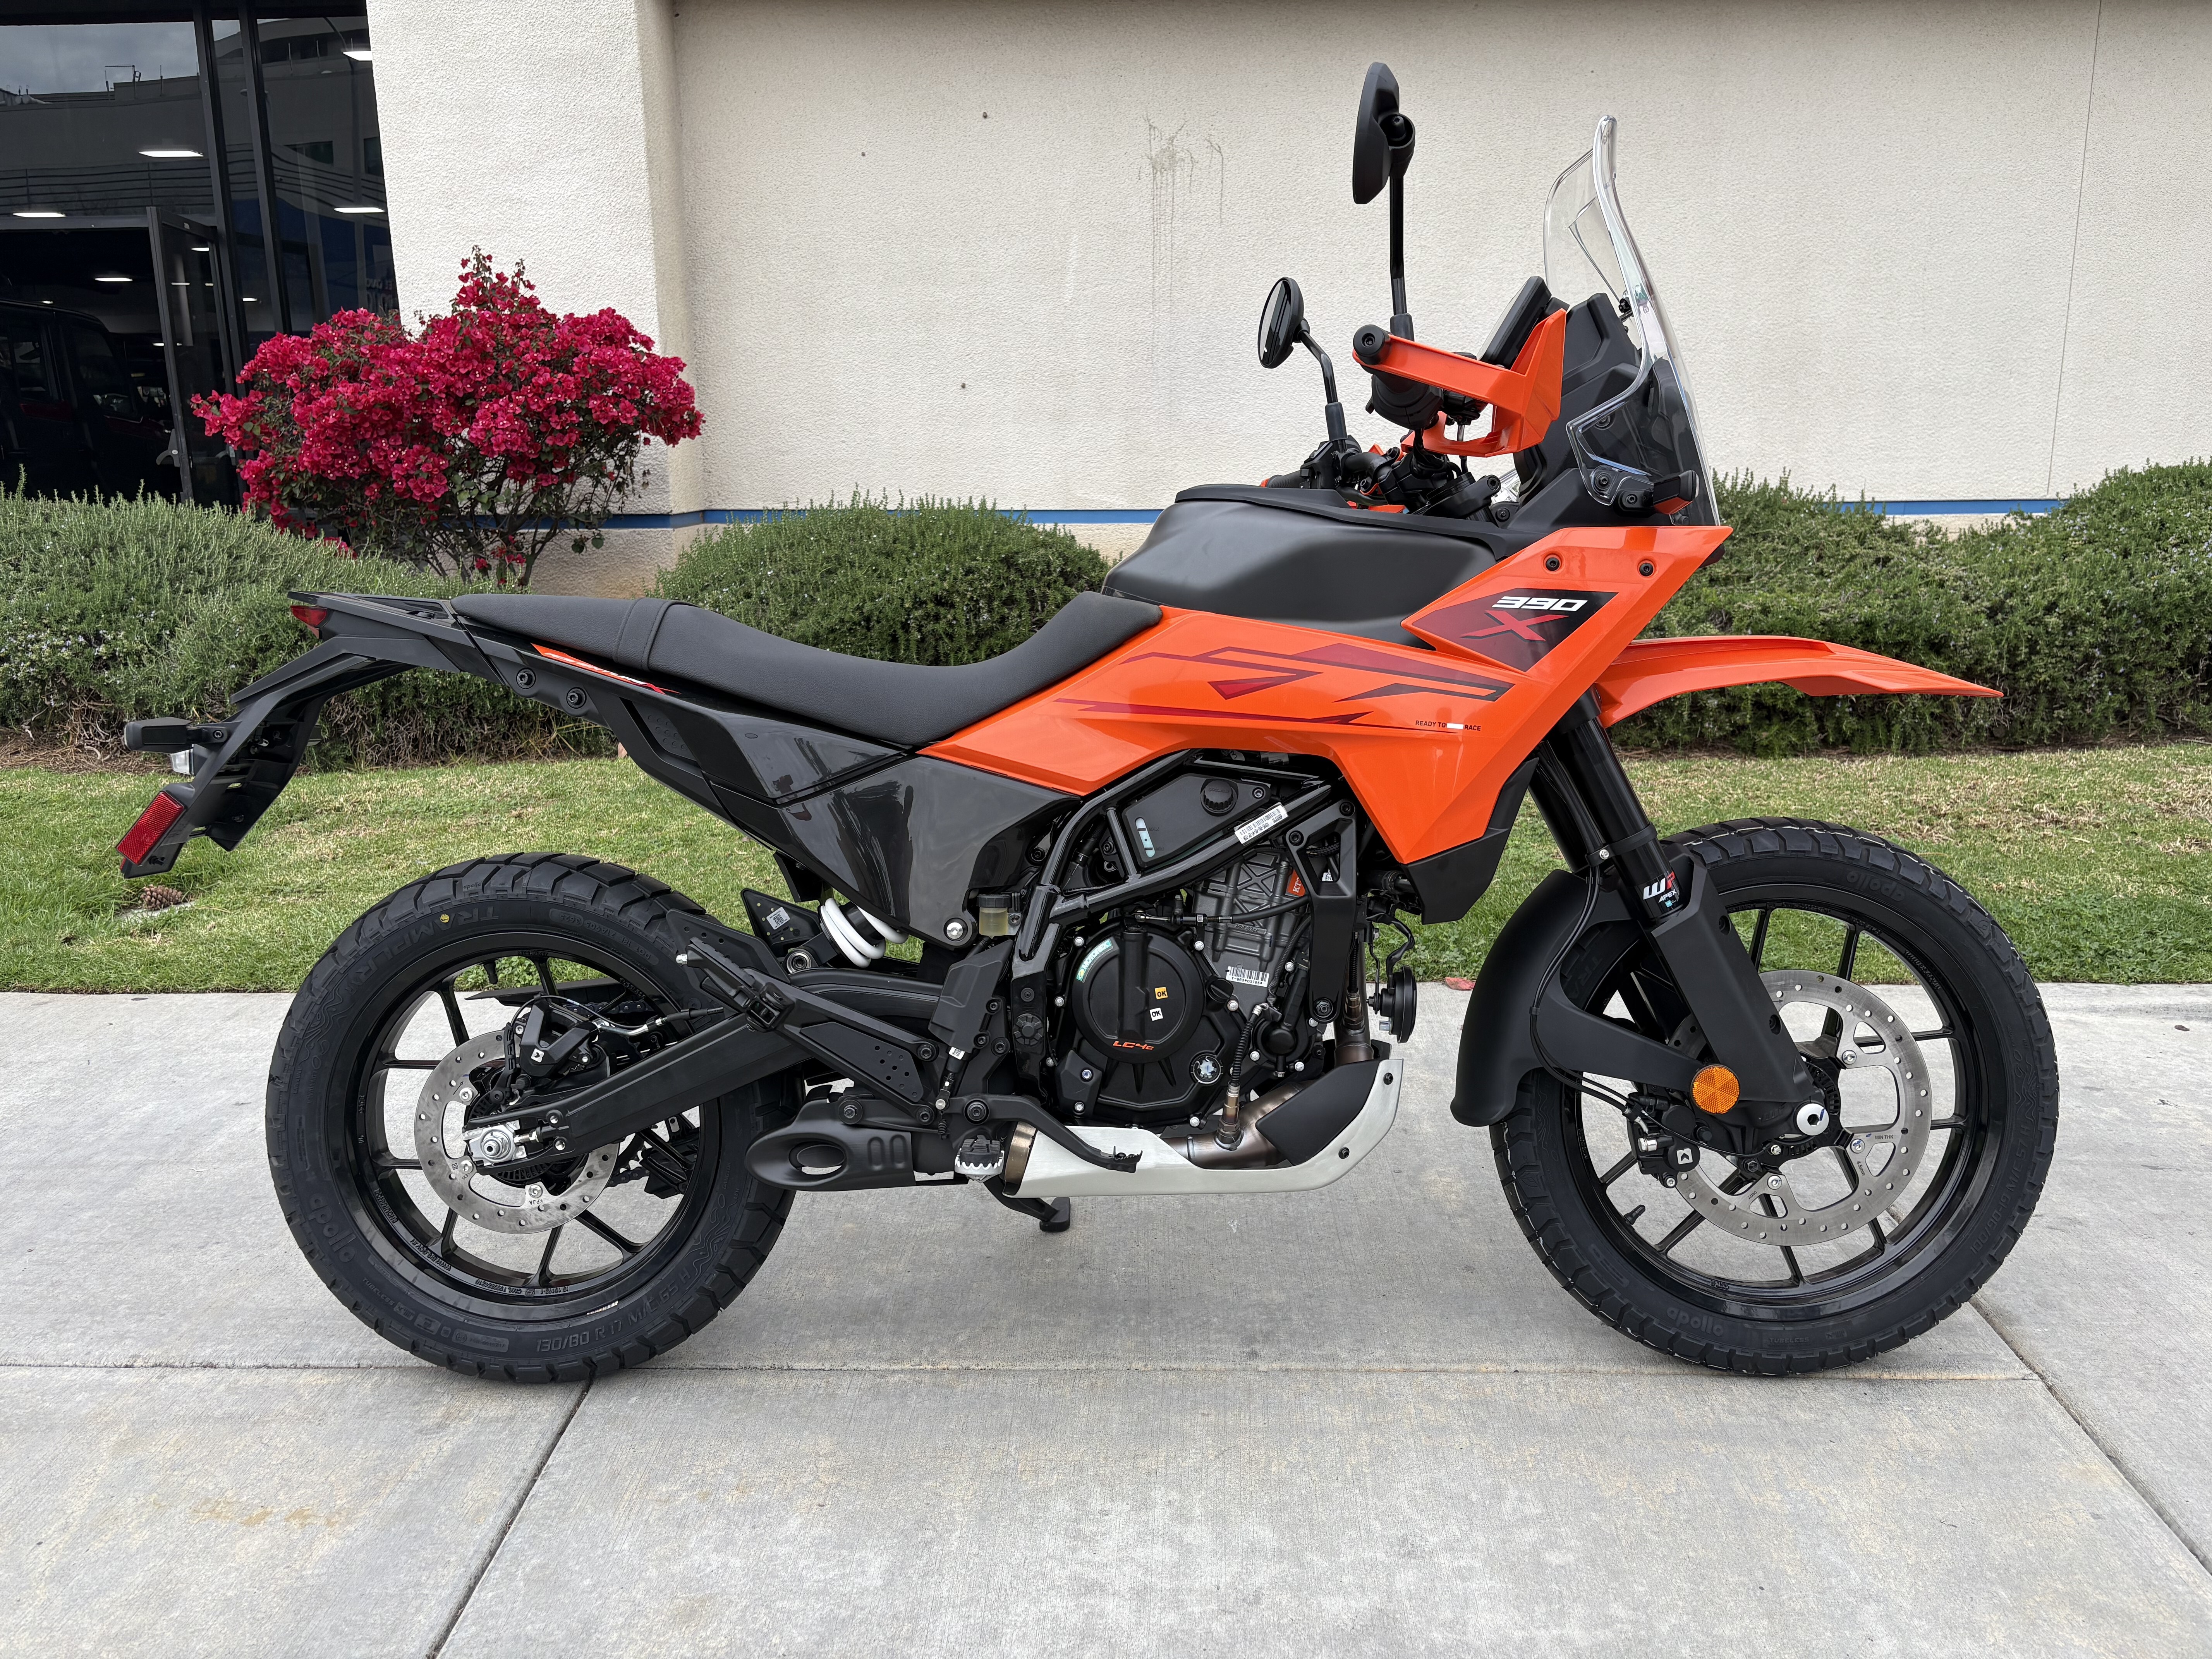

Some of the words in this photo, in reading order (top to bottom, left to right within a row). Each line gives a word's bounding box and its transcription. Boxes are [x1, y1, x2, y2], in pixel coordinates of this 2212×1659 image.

[1492, 596, 1588, 611] 390
[1658, 889, 1677, 903] APEX
[1847, 870, 1906, 903] apollo
[560, 914, 580, 924] 3625
[1083, 939, 1111, 969] MOTOREX
[1856, 1161, 1865, 1176] 4.5mm
[308, 1195, 357, 1262] apollo
[1666, 1306, 1724, 1337] apollo
[536, 1331, 590, 1352] 130/80
